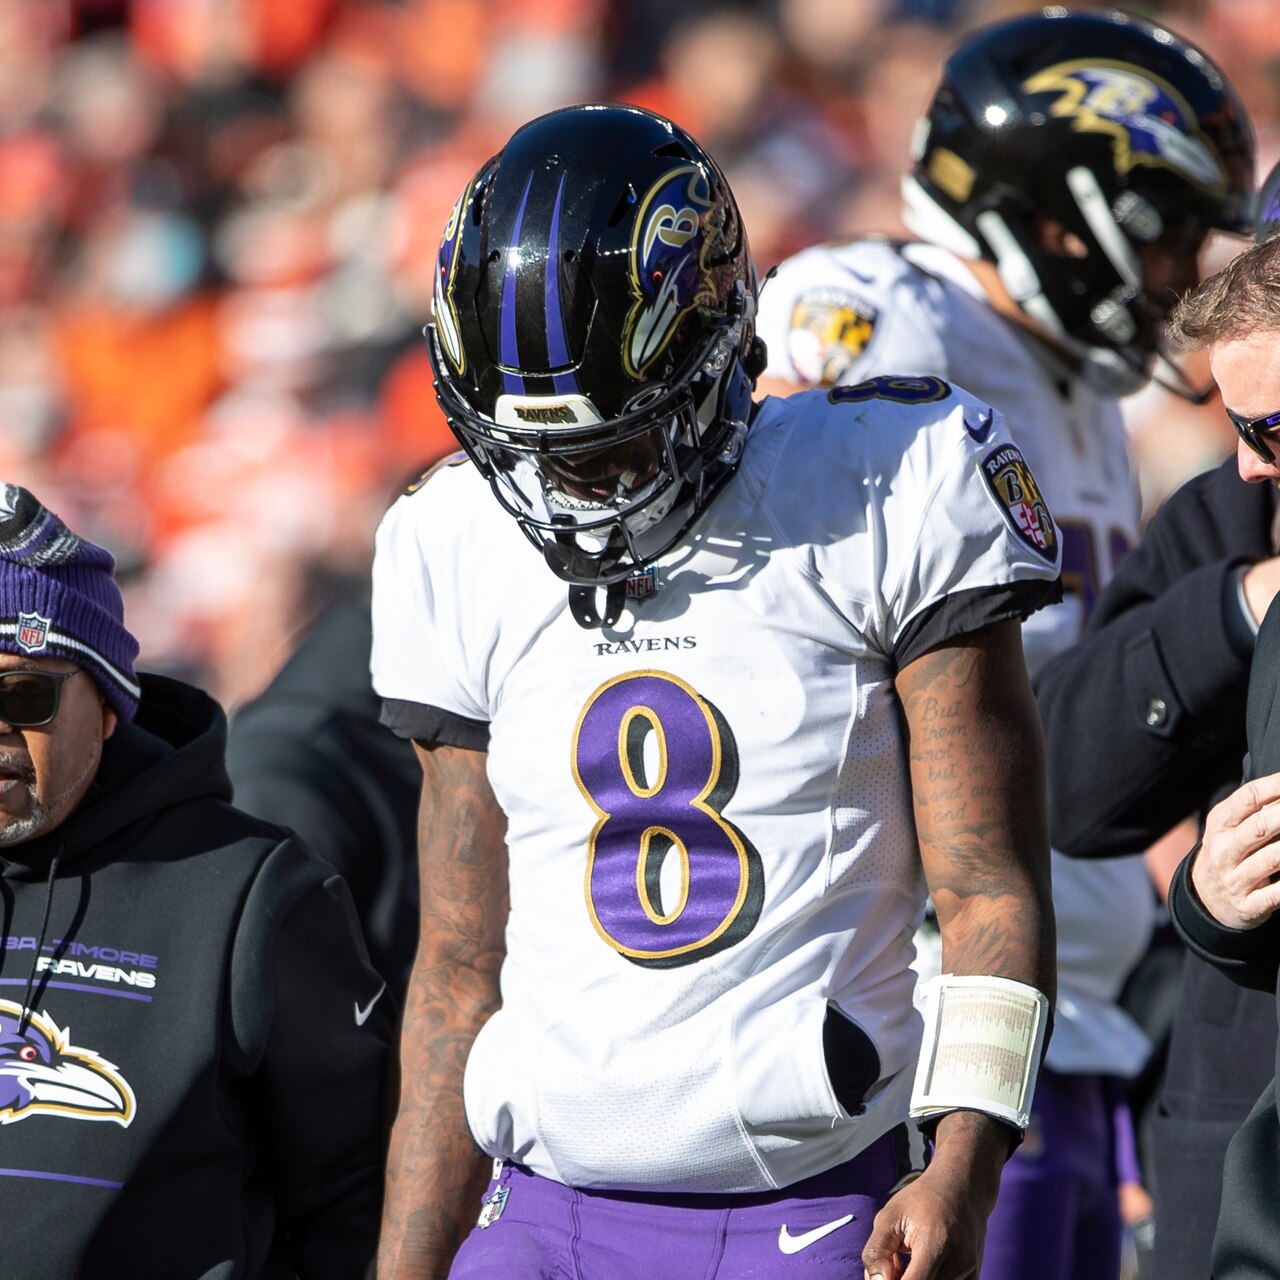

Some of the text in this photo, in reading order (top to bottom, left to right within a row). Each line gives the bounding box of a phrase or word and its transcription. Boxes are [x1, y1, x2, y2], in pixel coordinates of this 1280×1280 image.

[514, 403, 578, 424] RAVENS
[986, 449, 1023, 475] RAVEN
[625, 577, 652, 597] NFL
[21, 628, 42, 646] NFL
[593, 635, 697, 656] RAVENS
[571, 669, 766, 970] 8
[36, 956, 157, 989] RAVENS
